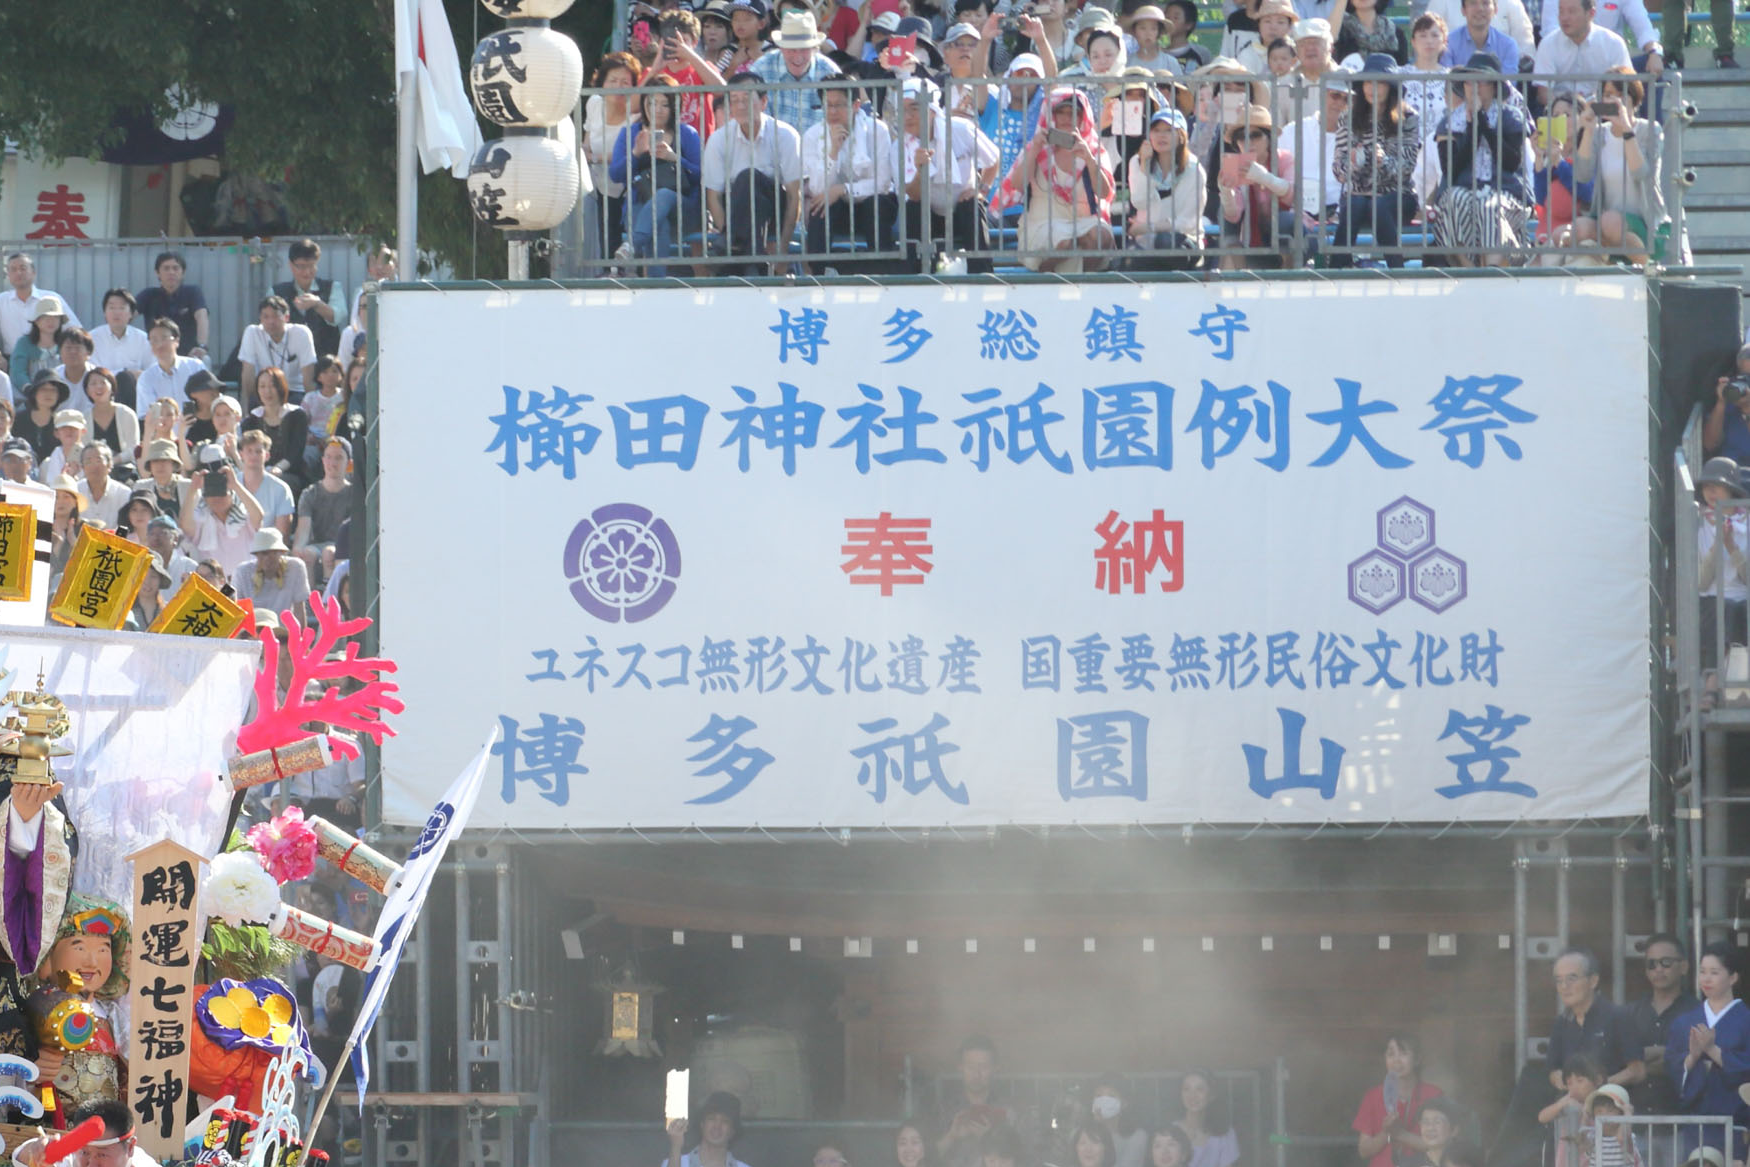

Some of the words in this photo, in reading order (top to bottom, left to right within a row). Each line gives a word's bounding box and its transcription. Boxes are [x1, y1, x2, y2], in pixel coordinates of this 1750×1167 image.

[770, 304, 1250, 364] 博多総鎮守
[484, 373, 1539, 481] 櫛田神社祇園例大祭
[79, 546, 124, 619] 祇園宮
[525, 634, 982, 696] ユネスコ無形文化遺産
[1021, 628, 1505, 694] 国重要無形民俗文化財
[492, 704, 1539, 808] 博多祇園山笠
